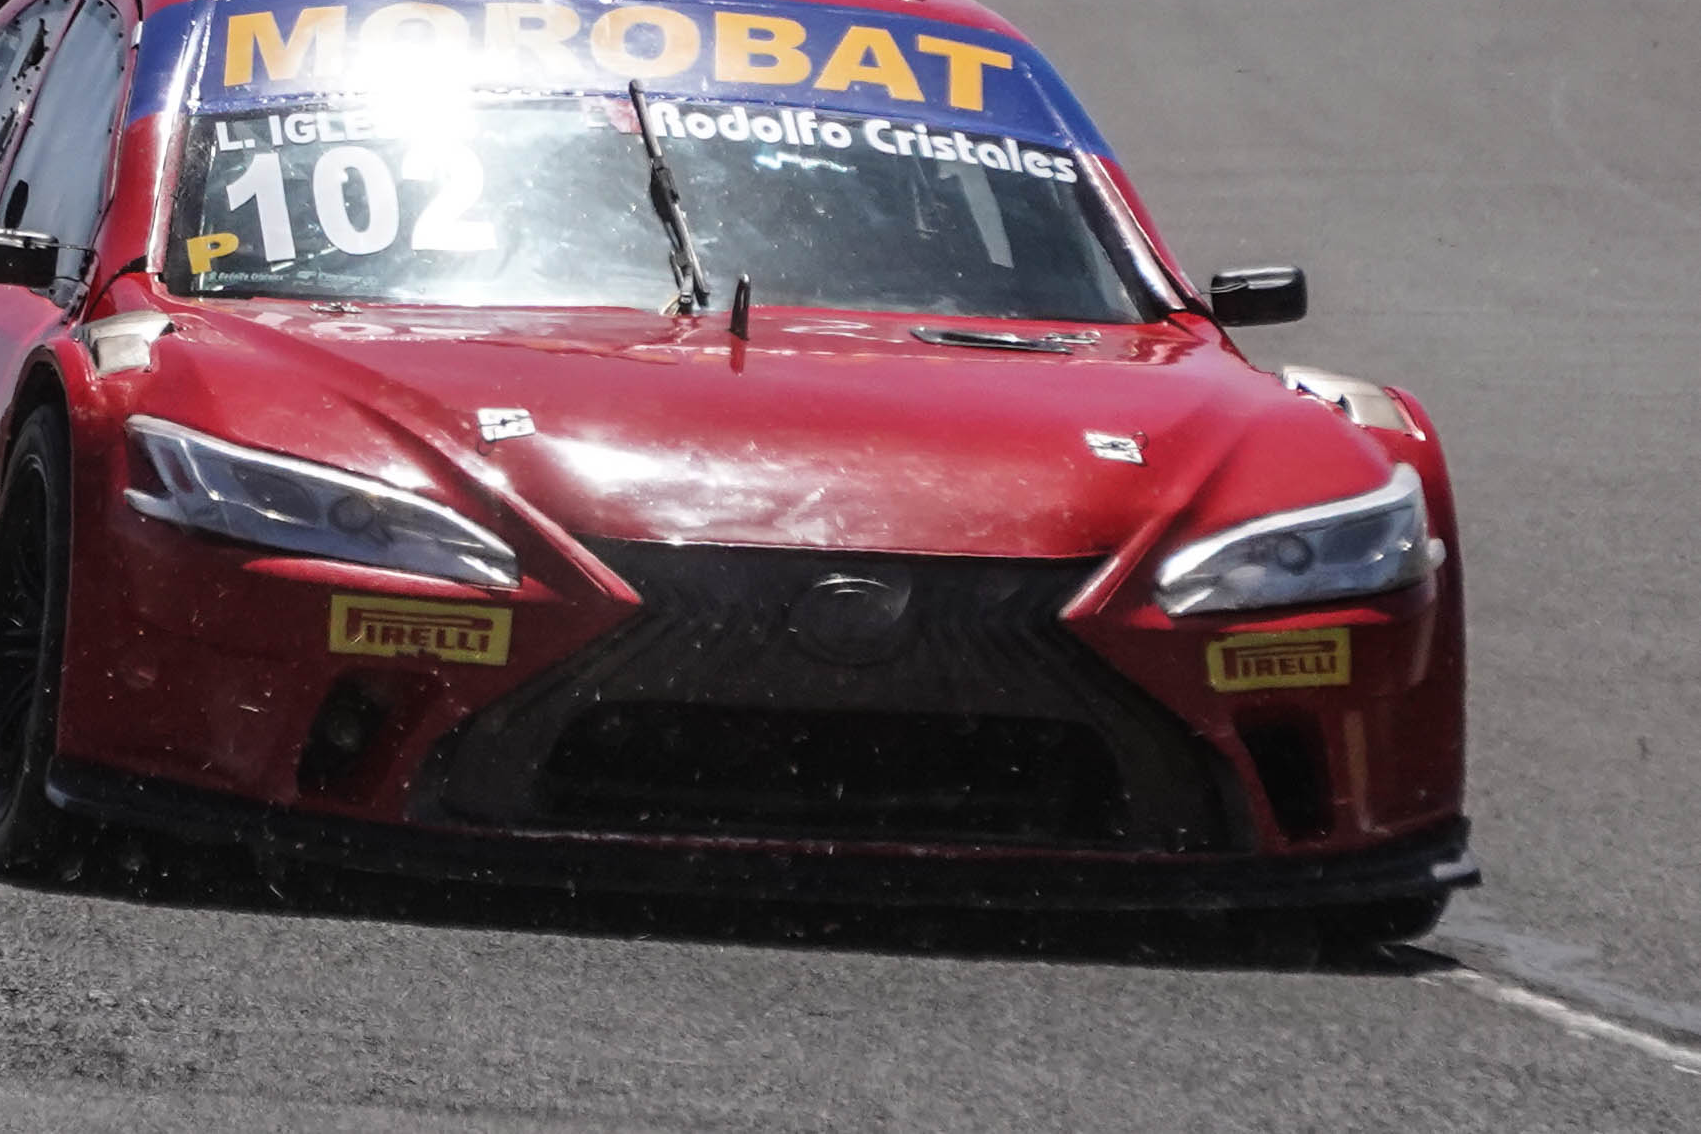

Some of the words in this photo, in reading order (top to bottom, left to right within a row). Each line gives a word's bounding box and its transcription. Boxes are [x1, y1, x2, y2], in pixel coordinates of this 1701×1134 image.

[648, 100, 852, 149] Rodolfo
[864, 118, 1078, 184] Cristales
[226, 144, 498, 262] 102
[186, 232, 240, 275] P
[346, 607, 495, 654] PIRELLI
[1221, 640, 1338, 681] PIRELLI
